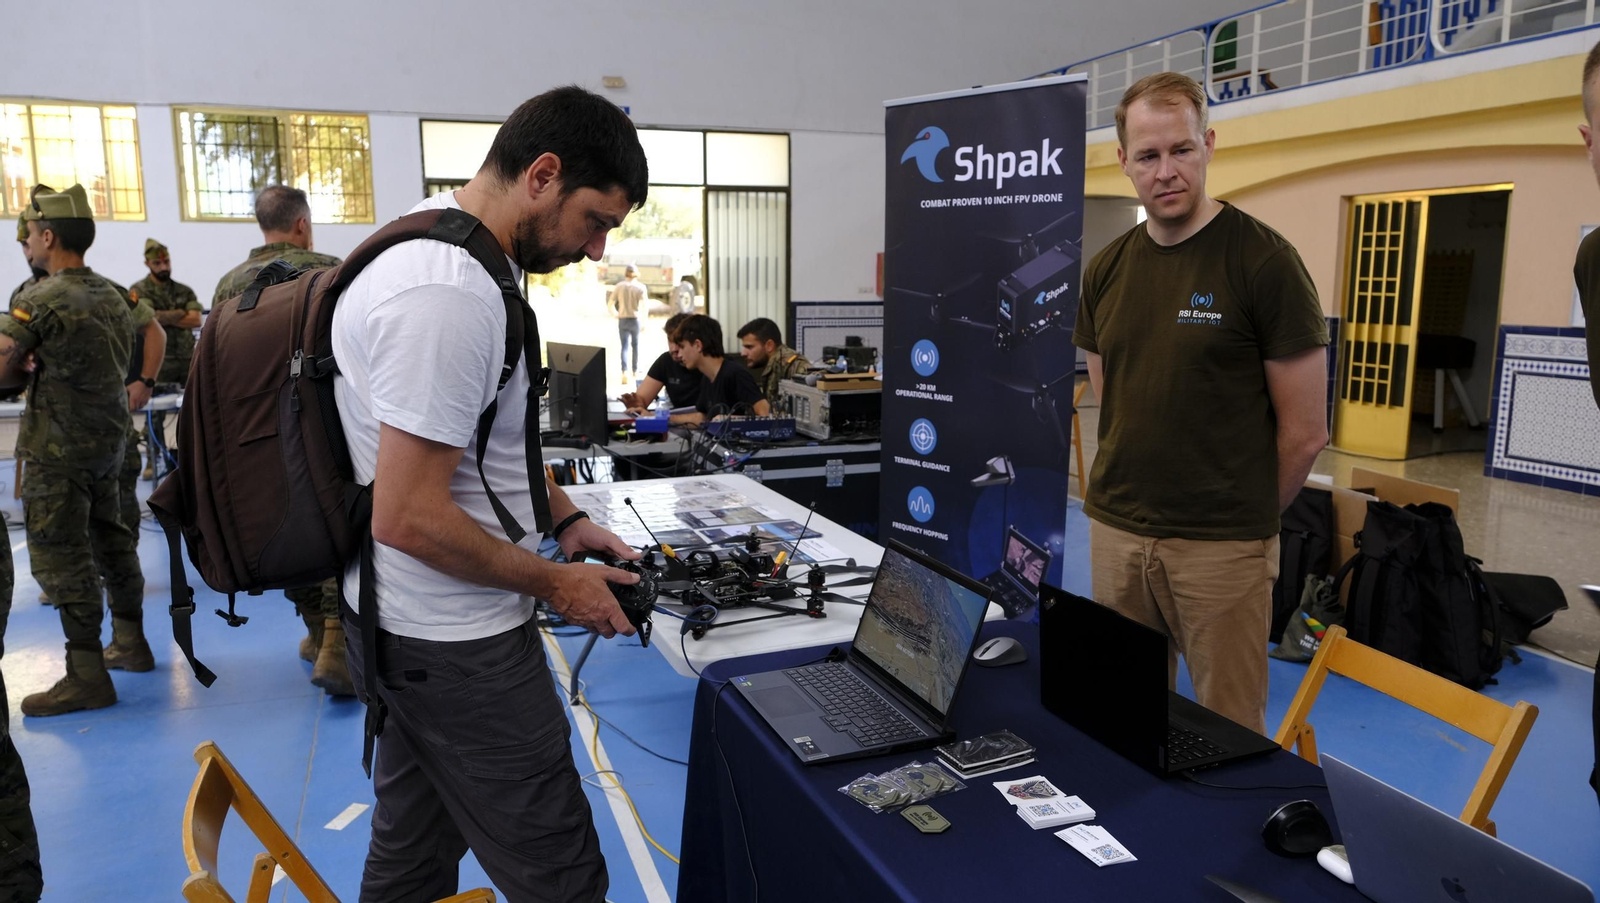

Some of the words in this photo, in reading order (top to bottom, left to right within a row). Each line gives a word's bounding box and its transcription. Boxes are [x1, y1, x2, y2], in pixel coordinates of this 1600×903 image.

[954, 138, 1063, 189] Shpak
[920, 199, 951, 208] COMBAT
[952, 197, 982, 207] PROVEN
[984, 196, 992, 205] 10
[994, 195, 1013, 204] INCH
[1014, 195, 1030, 204] FPV
[1032, 193, 1063, 203] DRONE
[1045, 282, 1069, 302] Shpak
[1178, 309, 1191, 318] RSI
[1192, 310, 1222, 320] Europe
[916, 383, 926, 391] >20
[895, 389, 933, 400] OPERATIONAL
[933, 393, 953, 402] RANGE
[894, 455, 921, 467] TERMINAL
[921, 461, 950, 472] GUIDANCE
[892, 521, 923, 534] FREQUENCY
[923, 529, 948, 541] HOPPING
[1300, 639, 1312, 649] THE
[1304, 634, 1315, 643] WE
